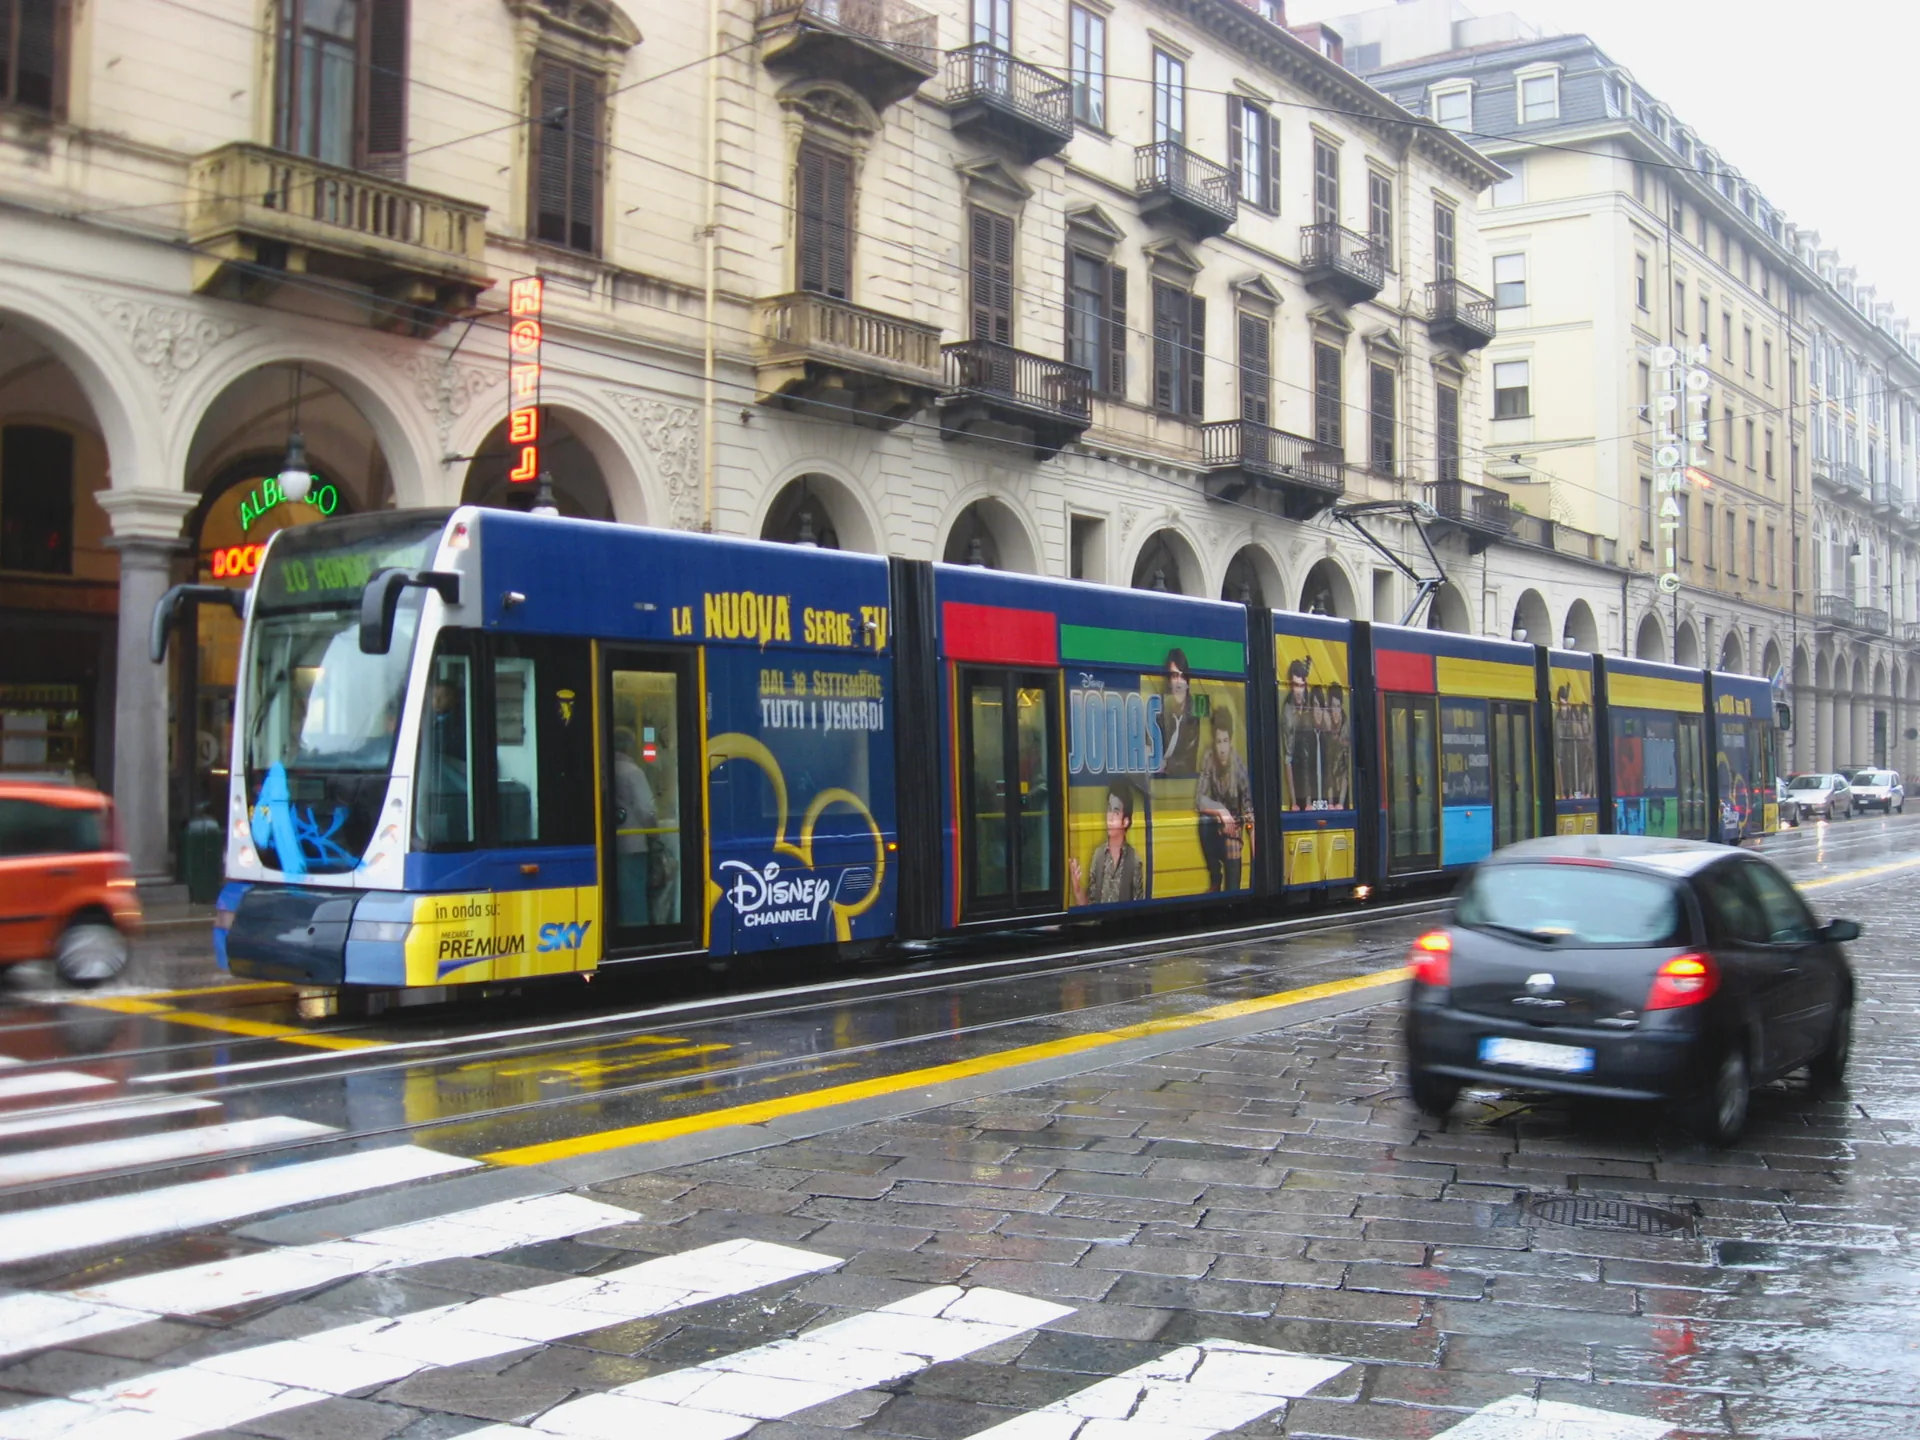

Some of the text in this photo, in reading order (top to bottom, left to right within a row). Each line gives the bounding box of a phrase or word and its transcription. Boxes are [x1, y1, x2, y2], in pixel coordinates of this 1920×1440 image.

[1685, 343, 1710, 466] HOTEL
[1655, 346, 1681, 593] DIPLOMATIC
[672, 591, 887, 654] LA NUOVA SERIE TV
[760, 669, 786, 696] DAL
[813, 670, 883, 698] SETTEMBRE
[761, 698, 804, 729] TUTTI
[811, 701, 817, 729] I
[1068, 689, 1165, 774] JONAS
[435, 902, 448, 919] in
[452, 898, 482, 919] onda
[744, 908, 812, 927] CHANNEL
[438, 934, 525, 959] PREMIUM
[441, 930, 474, 939] MEDIASET
